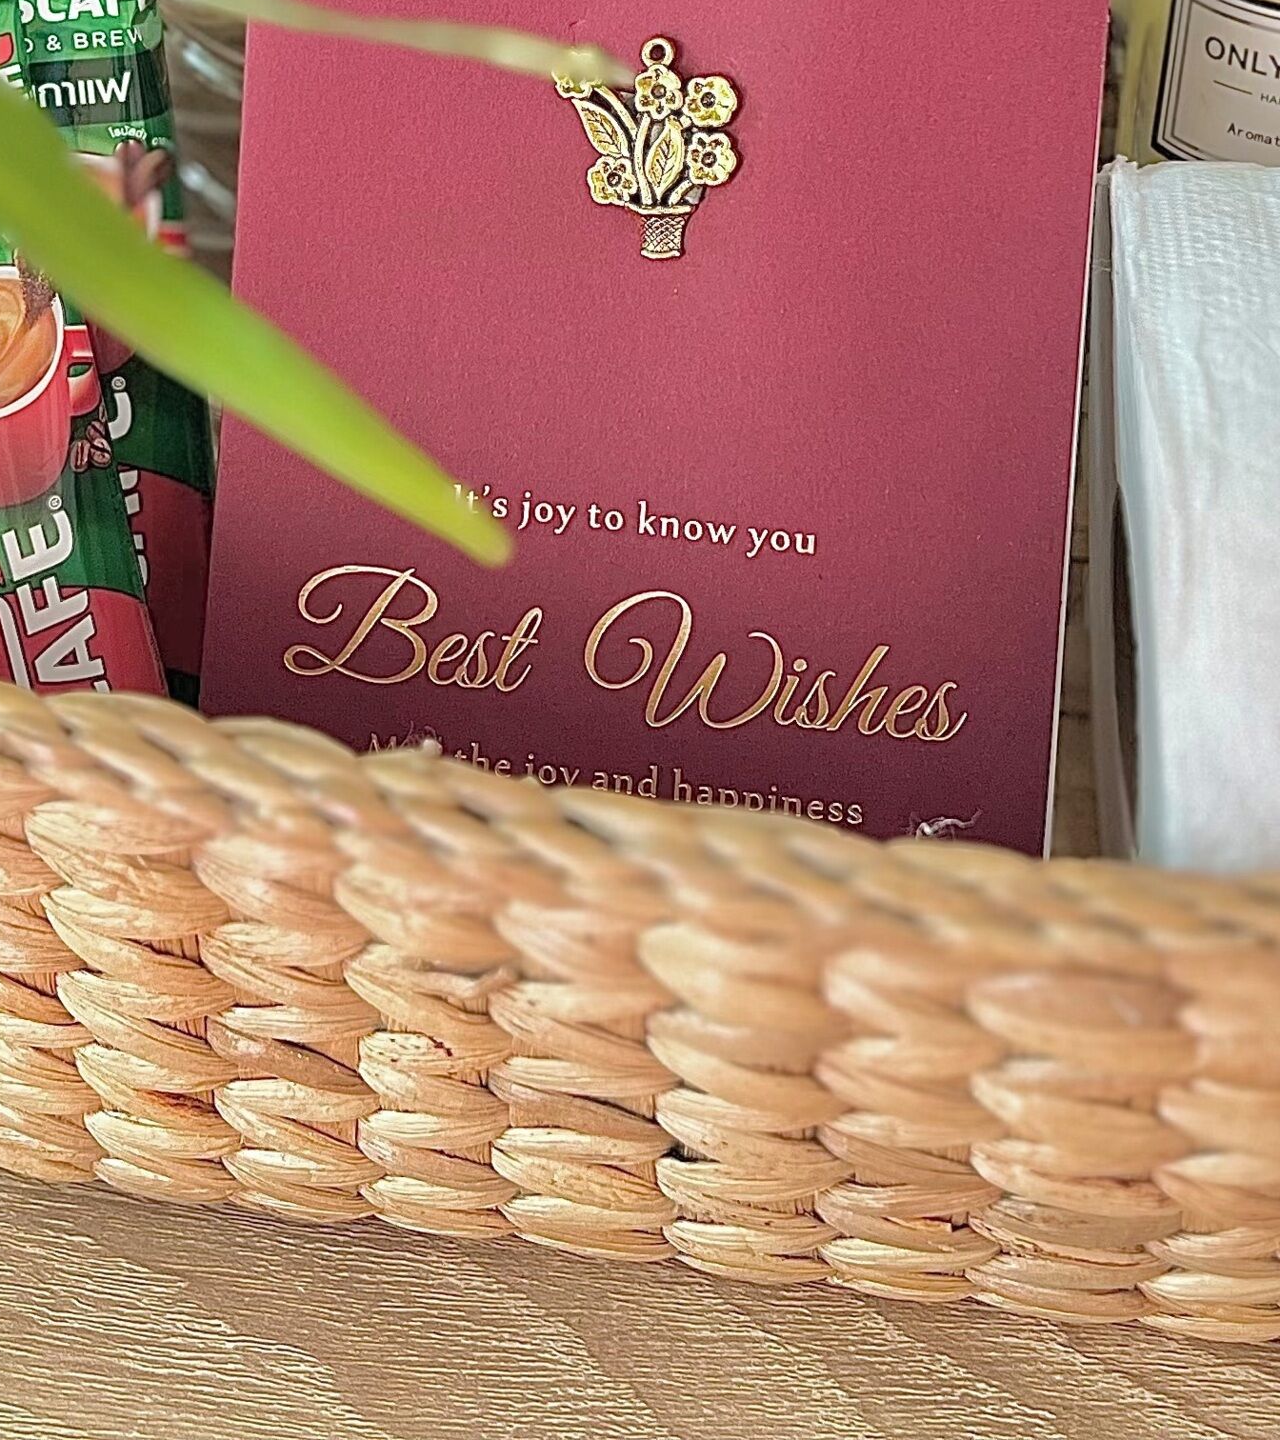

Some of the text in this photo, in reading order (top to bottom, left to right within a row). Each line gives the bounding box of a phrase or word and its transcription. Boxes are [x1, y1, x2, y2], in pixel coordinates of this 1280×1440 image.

[46, 34, 62, 51] &
[518, 491, 576, 534] joy
[588, 503, 624, 531] to
[638, 501, 737, 545] know
[746, 527, 816, 558] you
[283, 565, 968, 741] Best Wishes
[455, 742, 512, 778] the
[592, 765, 658, 799] and
[673, 768, 864, 824] happiness
